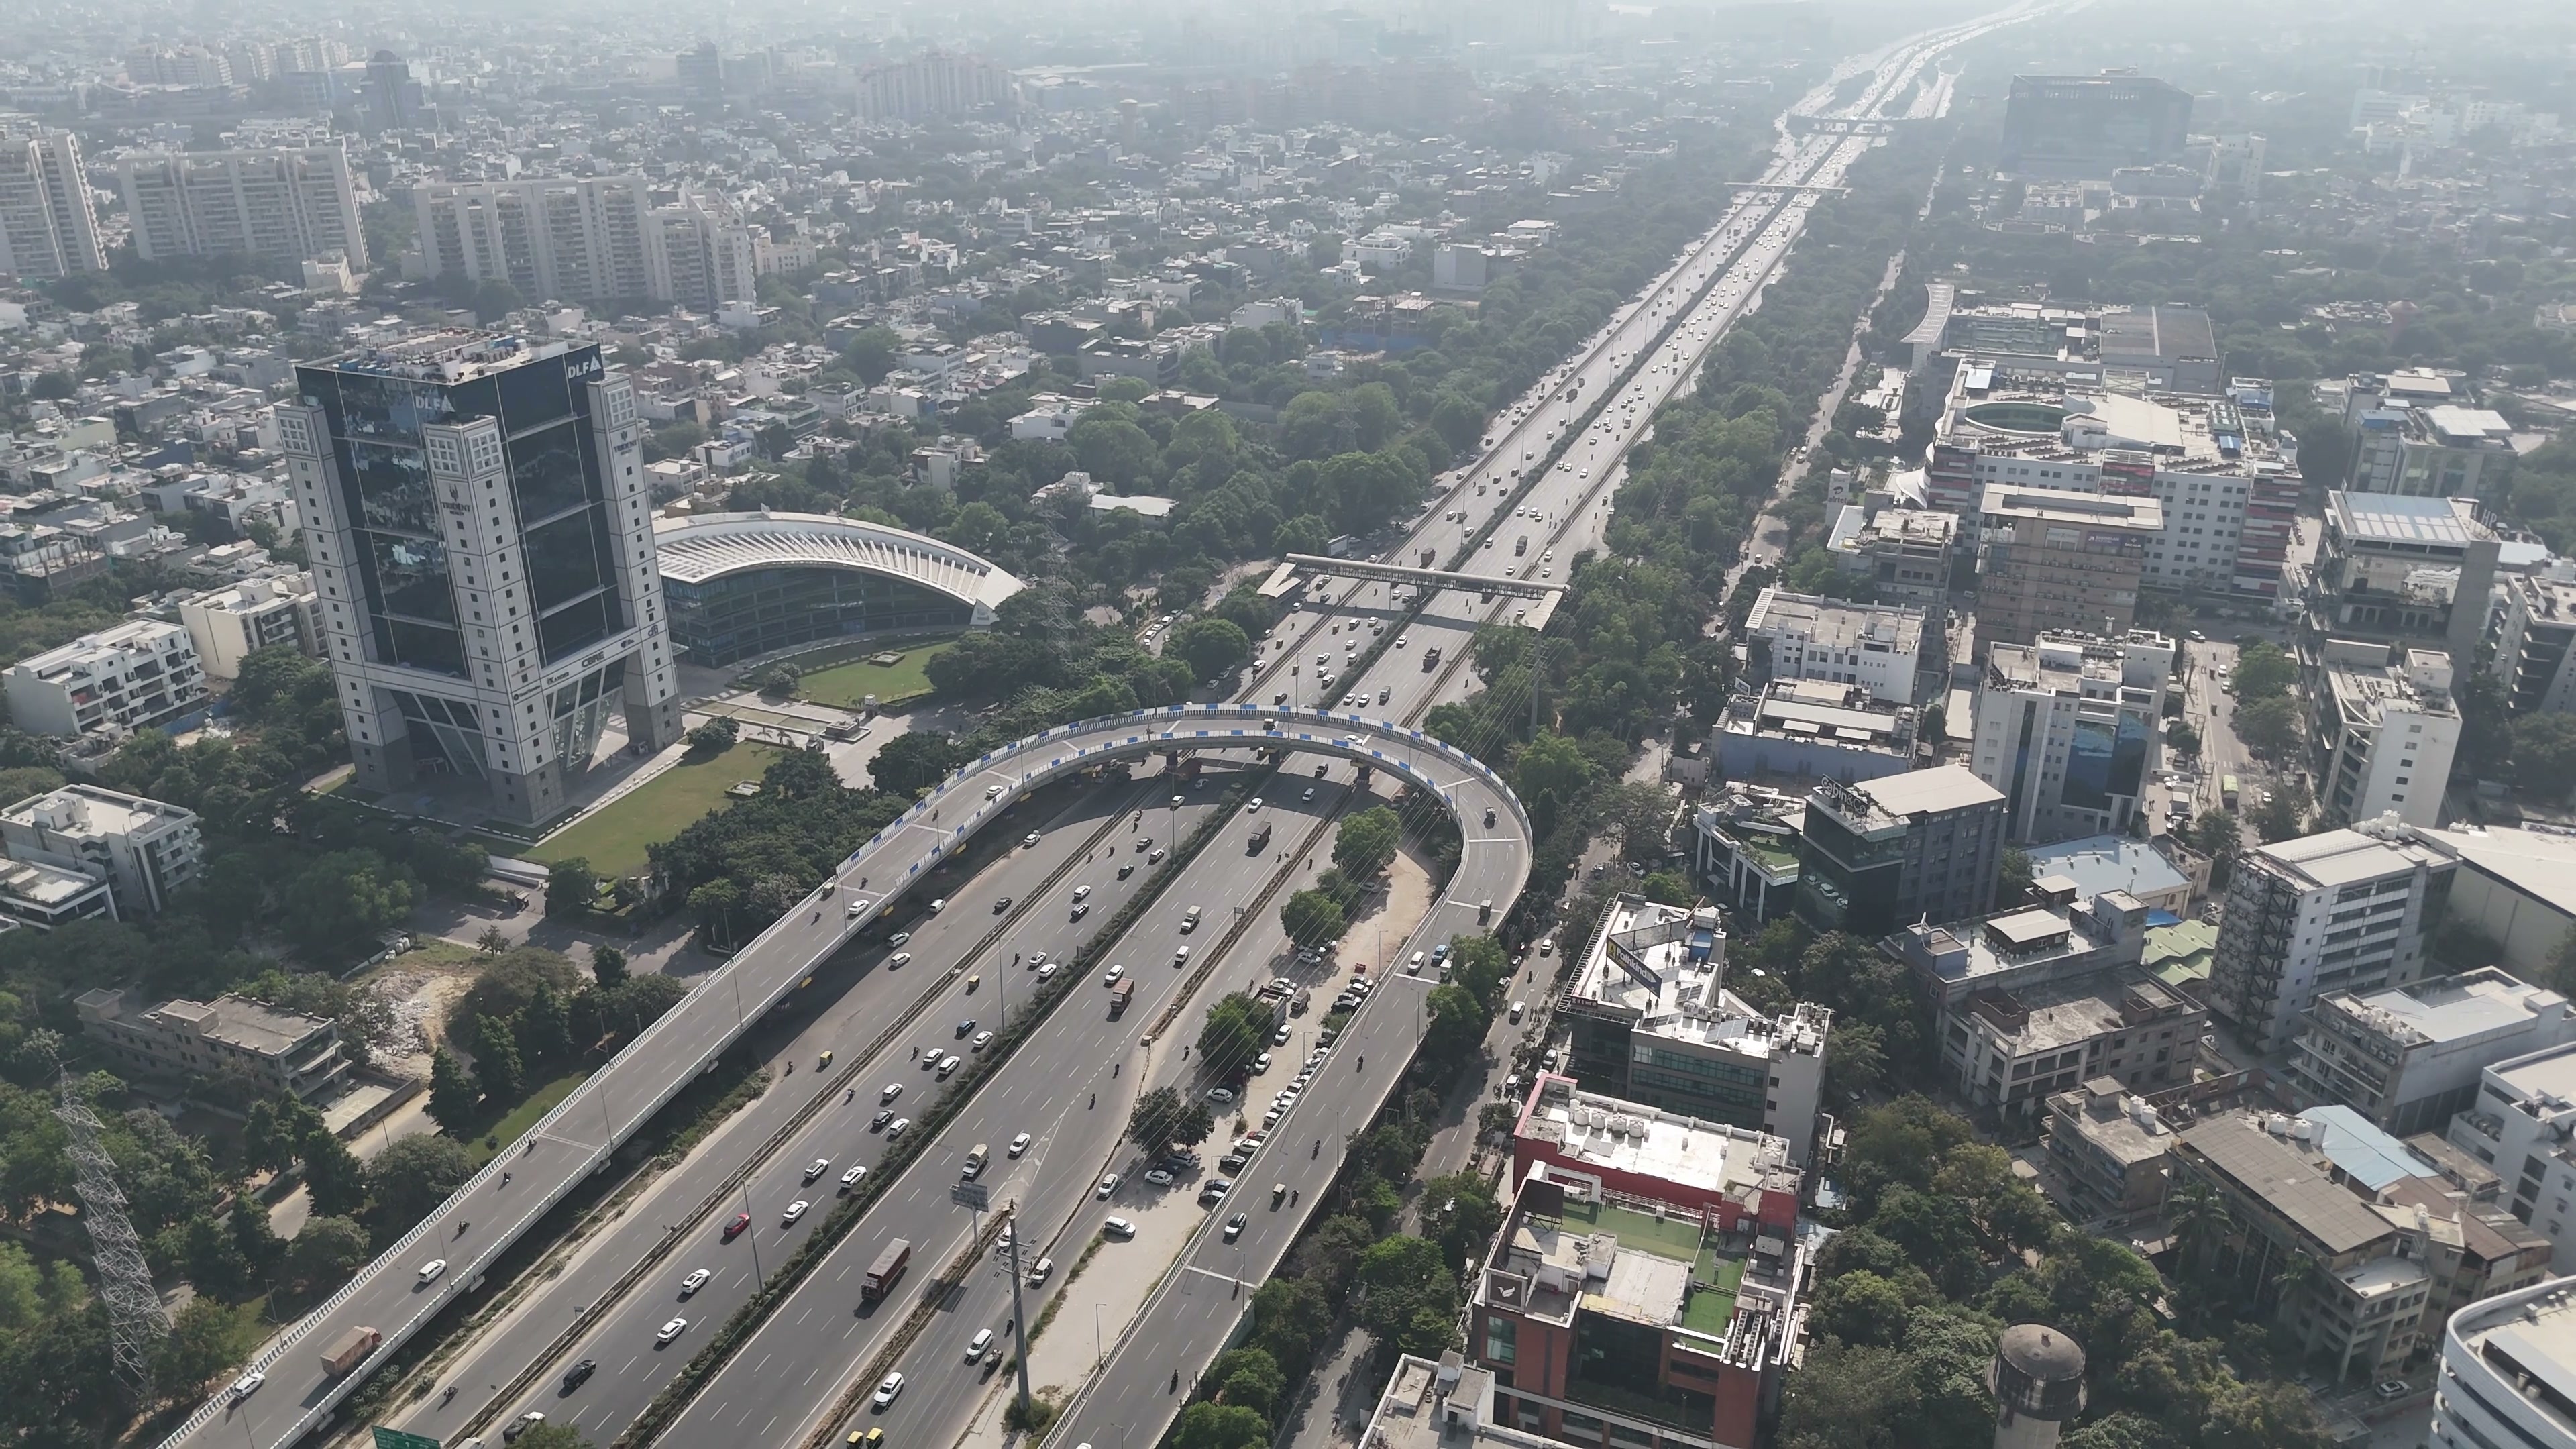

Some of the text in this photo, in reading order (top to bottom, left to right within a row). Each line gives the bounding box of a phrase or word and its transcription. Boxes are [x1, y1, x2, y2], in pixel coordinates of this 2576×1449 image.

[568, 361, 590, 379] DLF
[415, 396, 441, 411] DLF
[441, 502, 470, 512] TRIDENT
[582, 651, 604, 667] CBRE
[1821, 777, 1866, 814] Cabin&Co
[1617, 947, 1647, 978] Pathkind
